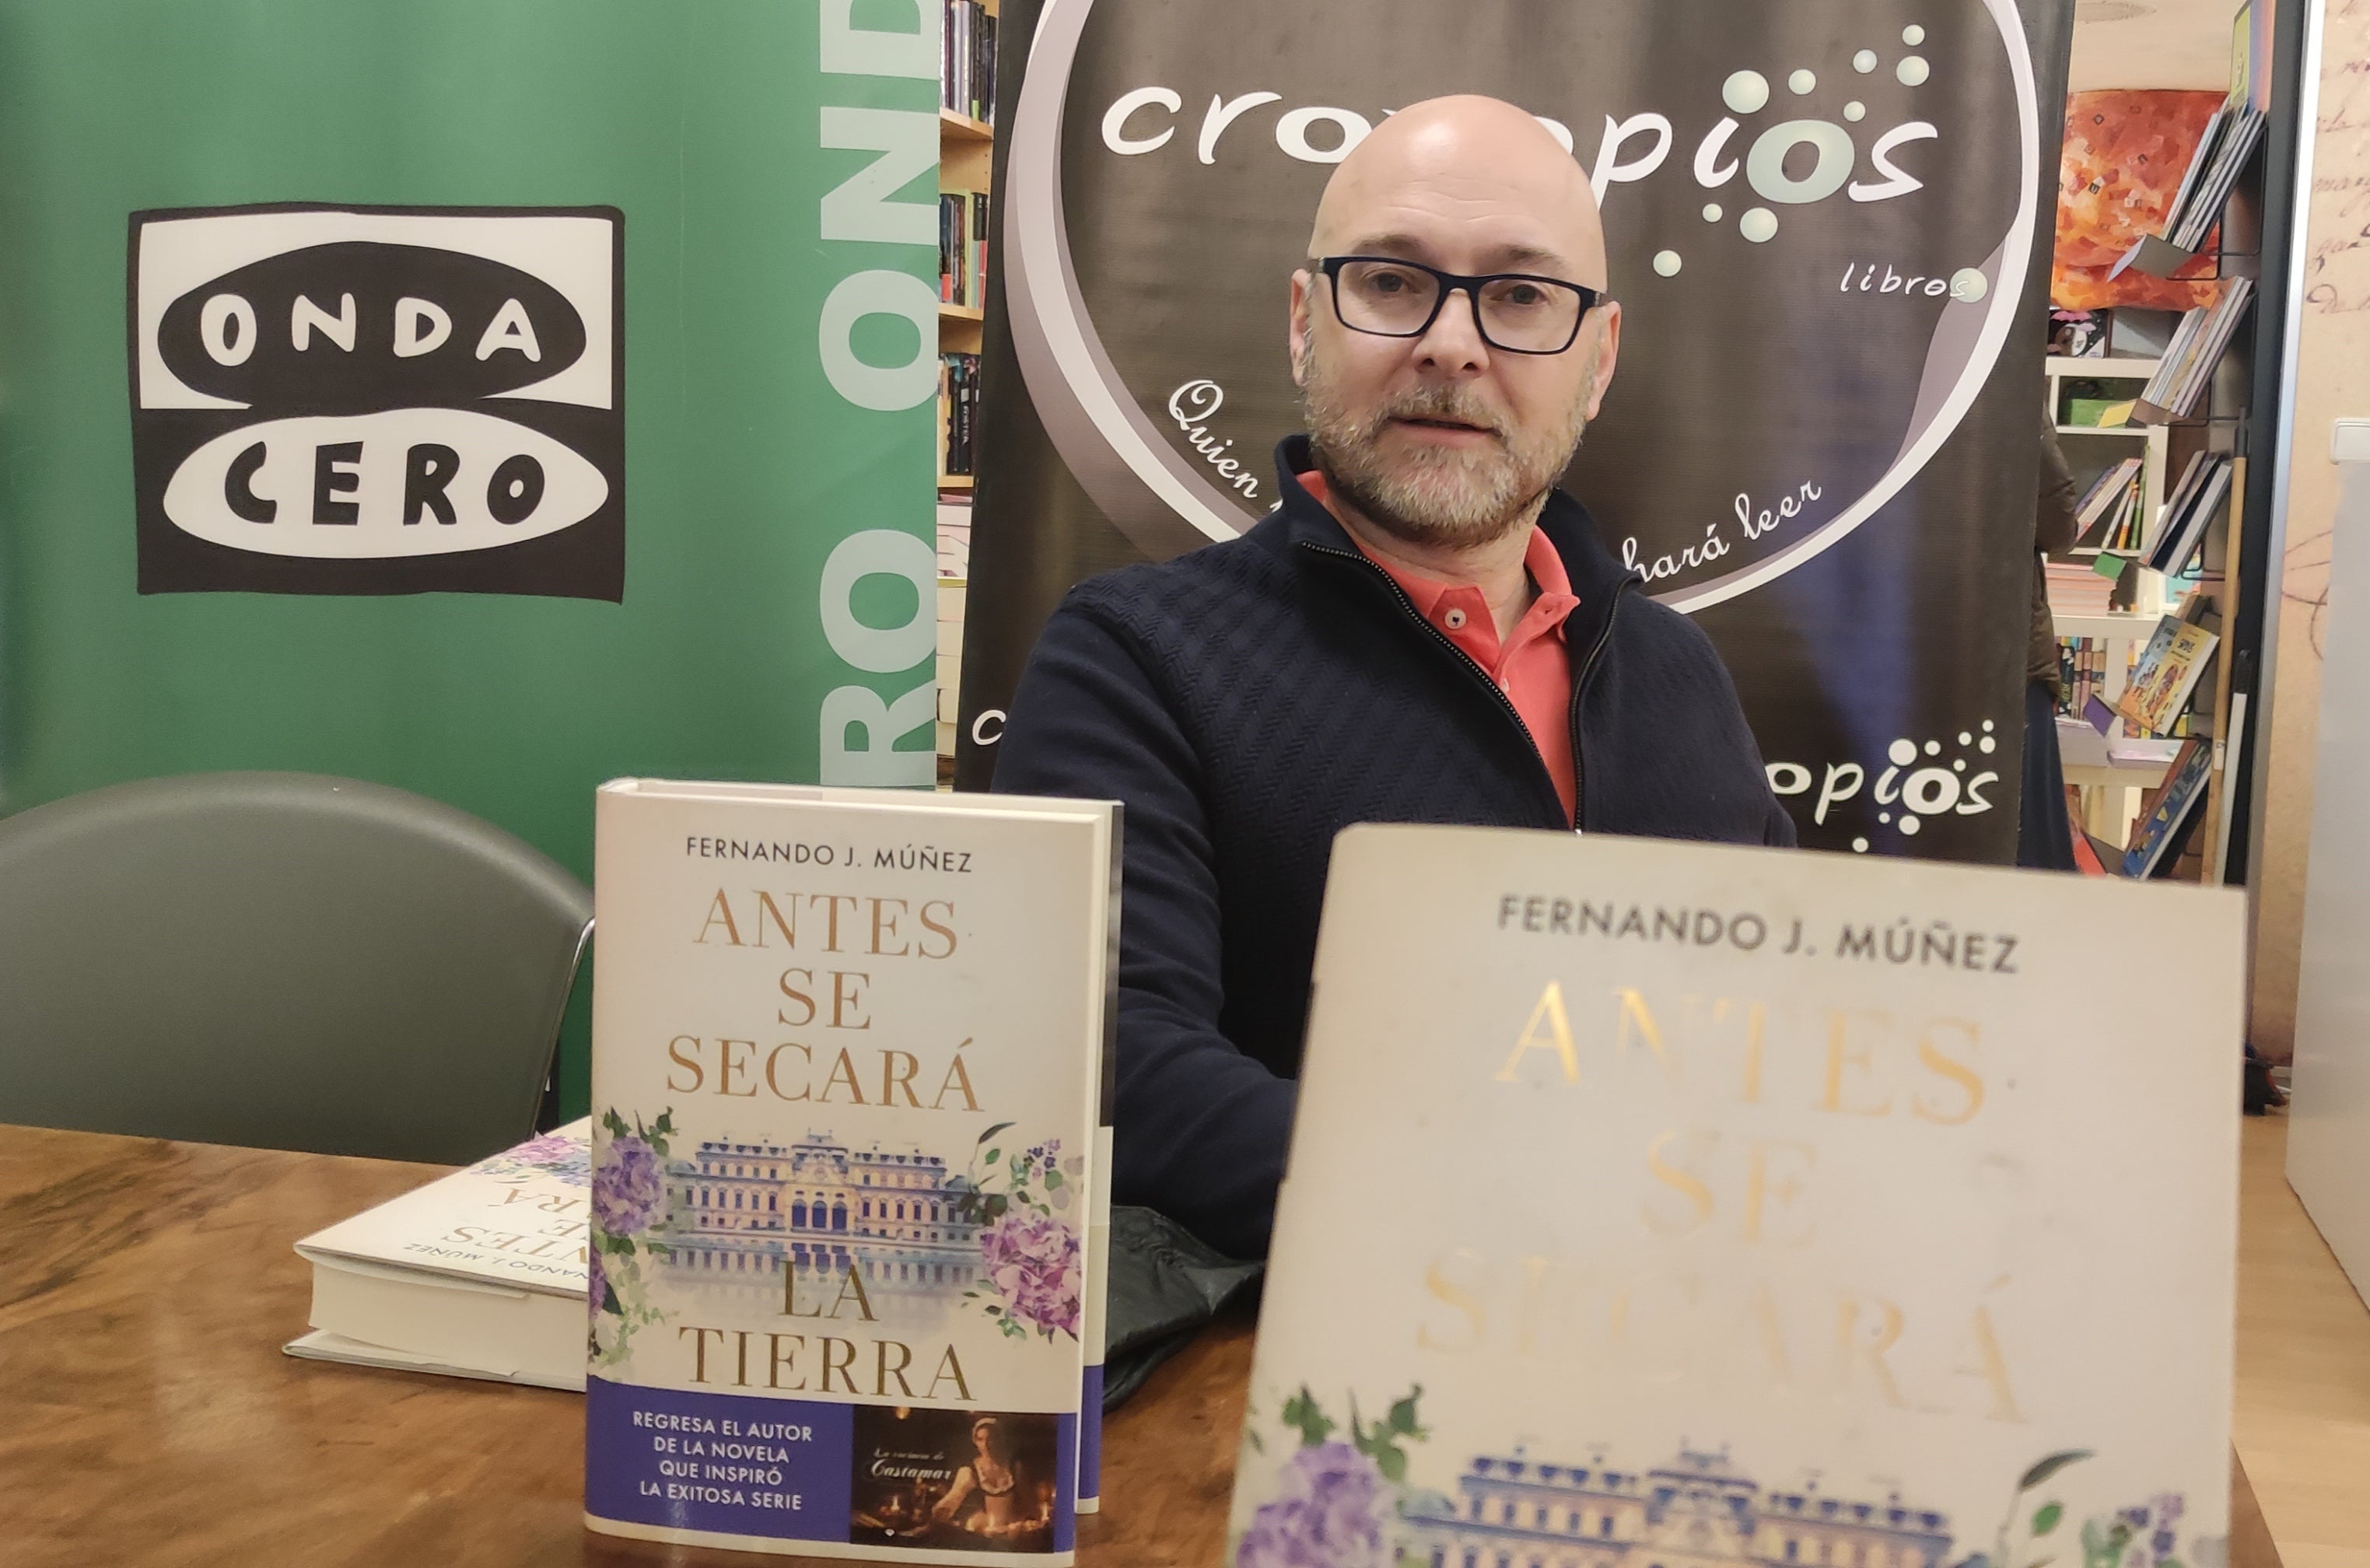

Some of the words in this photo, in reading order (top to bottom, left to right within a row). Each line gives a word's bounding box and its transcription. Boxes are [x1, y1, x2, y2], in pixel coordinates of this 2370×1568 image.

[1101, 70, 1938, 212] cropios
[819, 0, 940, 411] OND
[1840, 262, 1970, 299] libros
[201, 292, 541, 367] ONDA
[225, 441, 545, 525] CERO
[1168, 380, 1259, 499] Quien
[1735, 493, 1822, 540] leer
[819, 528, 937, 786] RO
[687, 837, 835, 866] FERNANDO
[845, 847, 862, 867] J.
[873, 844, 972, 873] MÚÑEZ
[693, 887, 959, 959] ANTES
[1497, 894, 1769, 950] FERNANDO
[1781, 918, 1819, 957] J.
[1836, 916, 2020, 974] MÚÑEZ
[778, 968, 871, 1031] SE
[667, 1035, 985, 1112] SECARÁ
[1640, 1127, 1819, 1251] SE
[779, 1260, 880, 1321] LA
[678, 1326, 978, 1401] TIERRA
[632, 1411, 716, 1434] REGRESA
[722, 1419, 741, 1437] EL
[747, 1423, 812, 1442] AUTOR
[653, 1437, 677, 1453] DE
[683, 1440, 705, 1456] LA
[711, 1443, 789, 1464] NOVELA
[640, 1481, 661, 1497] LA
[667, 1483, 745, 1506] EXITOSA
[751, 1492, 802, 1510] SERIE
[659, 1460, 699, 1479] QUE
[705, 1465, 782, 1486] INSPIRÓ
